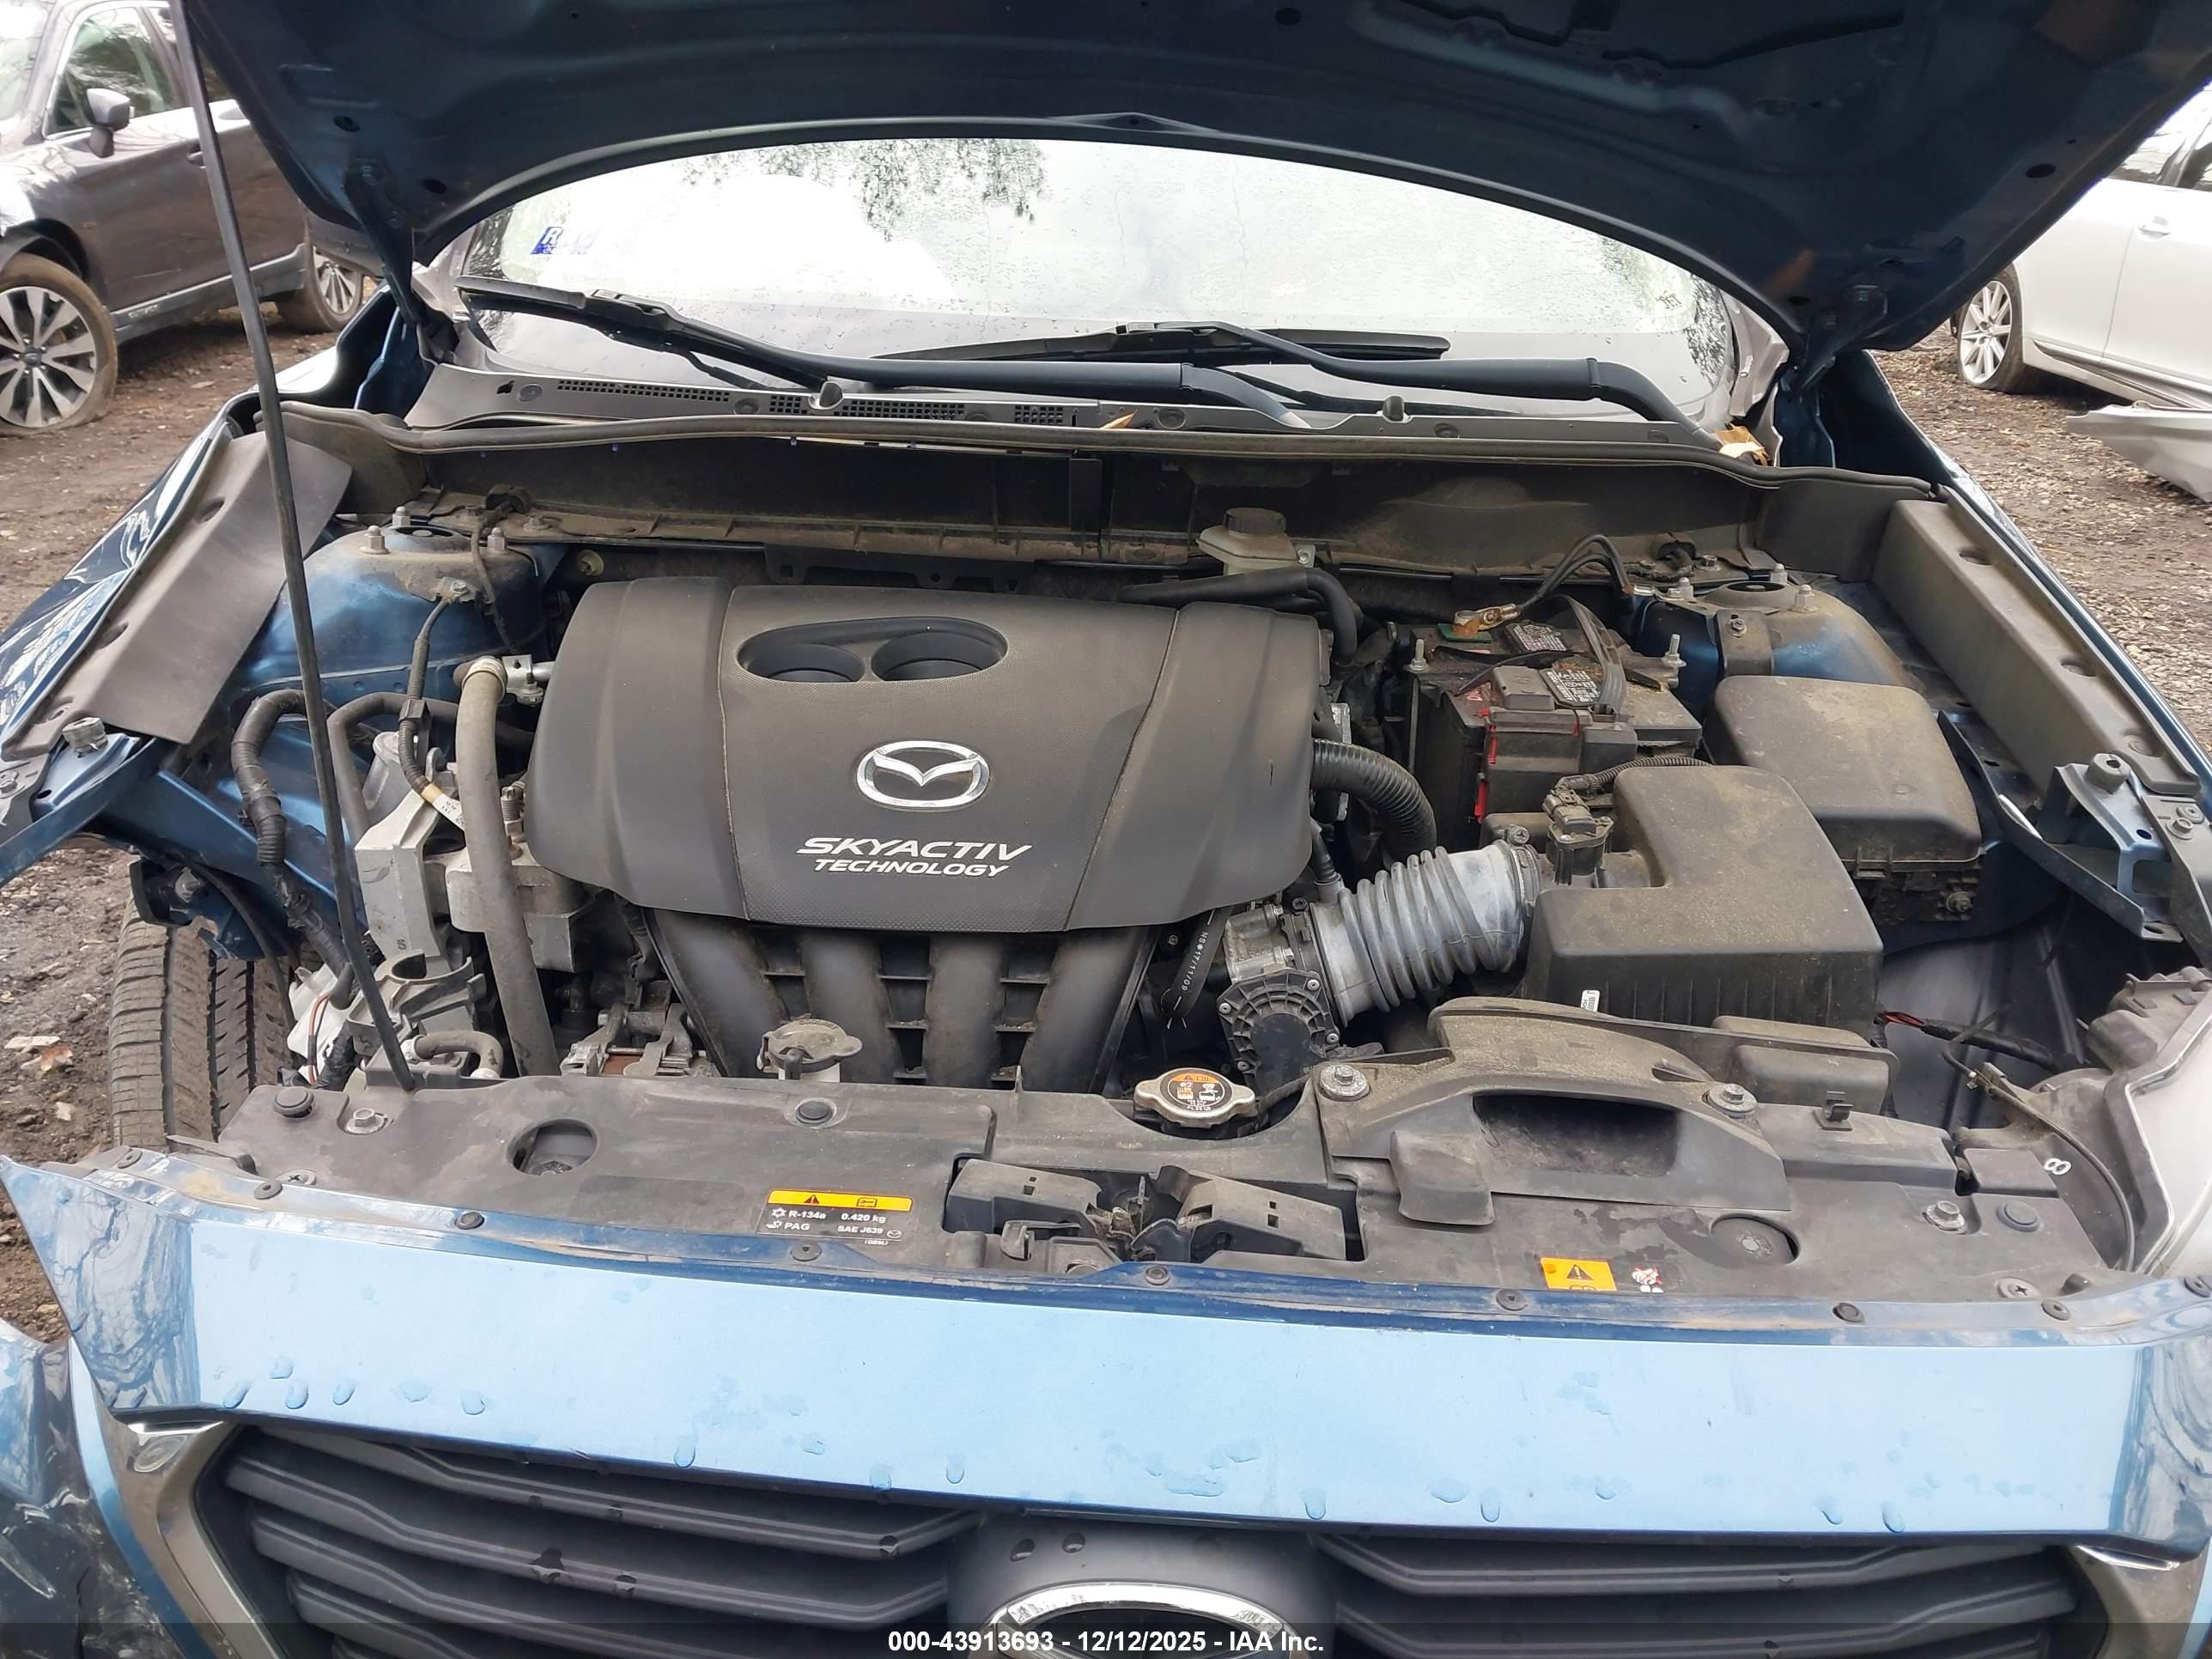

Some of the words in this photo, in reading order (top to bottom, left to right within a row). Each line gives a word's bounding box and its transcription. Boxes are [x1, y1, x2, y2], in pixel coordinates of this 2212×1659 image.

[796, 837, 1032, 860] SKYACTIV
[815, 859, 1009, 878] TECHNOLOGY
[788, 1210, 827, 1219] R-134a
[841, 1212, 871, 1222] 0.420
[872, 1214, 887, 1224] kg
[784, 1222, 811, 1231] PAG
[837, 1224, 860, 1233] SAE
